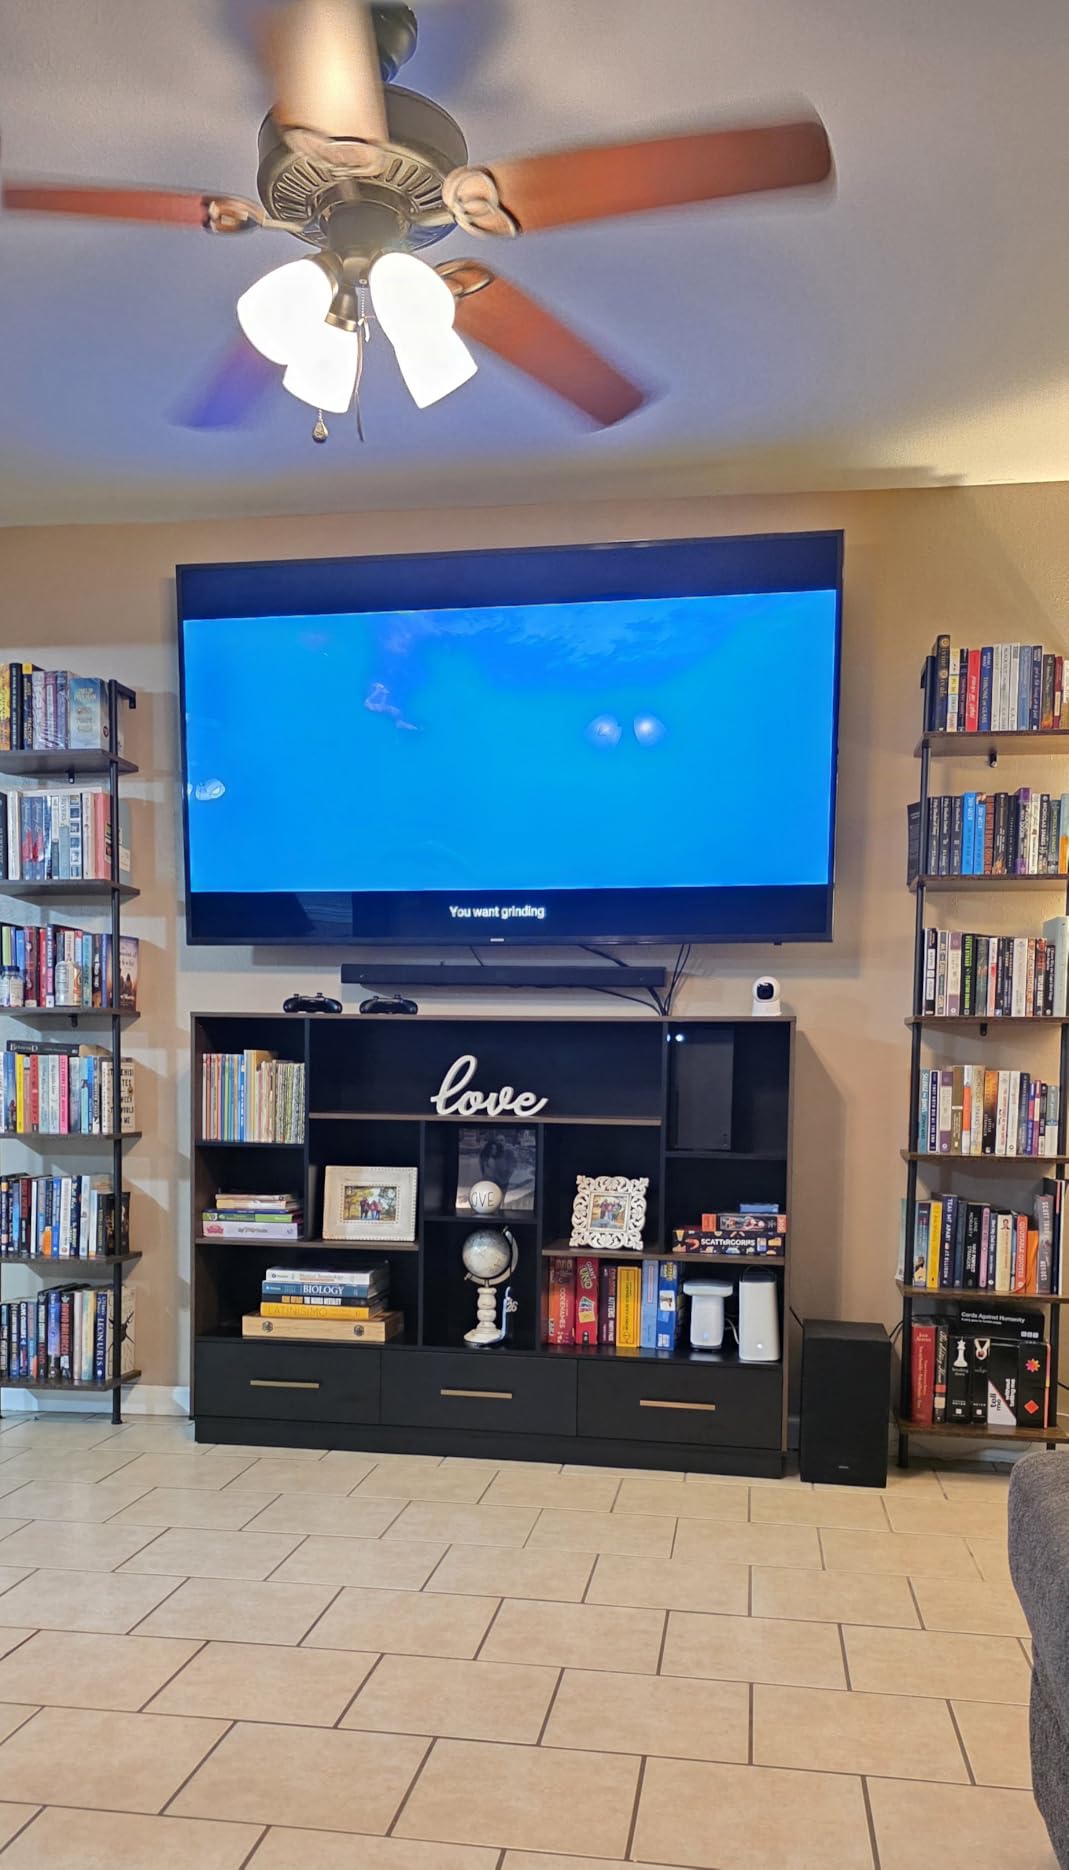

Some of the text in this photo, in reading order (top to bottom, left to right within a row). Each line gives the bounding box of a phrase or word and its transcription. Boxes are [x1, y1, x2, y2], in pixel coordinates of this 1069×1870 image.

[449, 905, 545, 919] You want grinding
[431, 1055, 549, 1117] love
[578, 1267, 592, 1289] UNO
[304, 1285, 344, 1294] BIOLOGY
[978, 1313, 999, 1321] Against
[999, 1316, 1025, 1324] Humanity
[61, 1324, 69, 1354] BALDACCI
